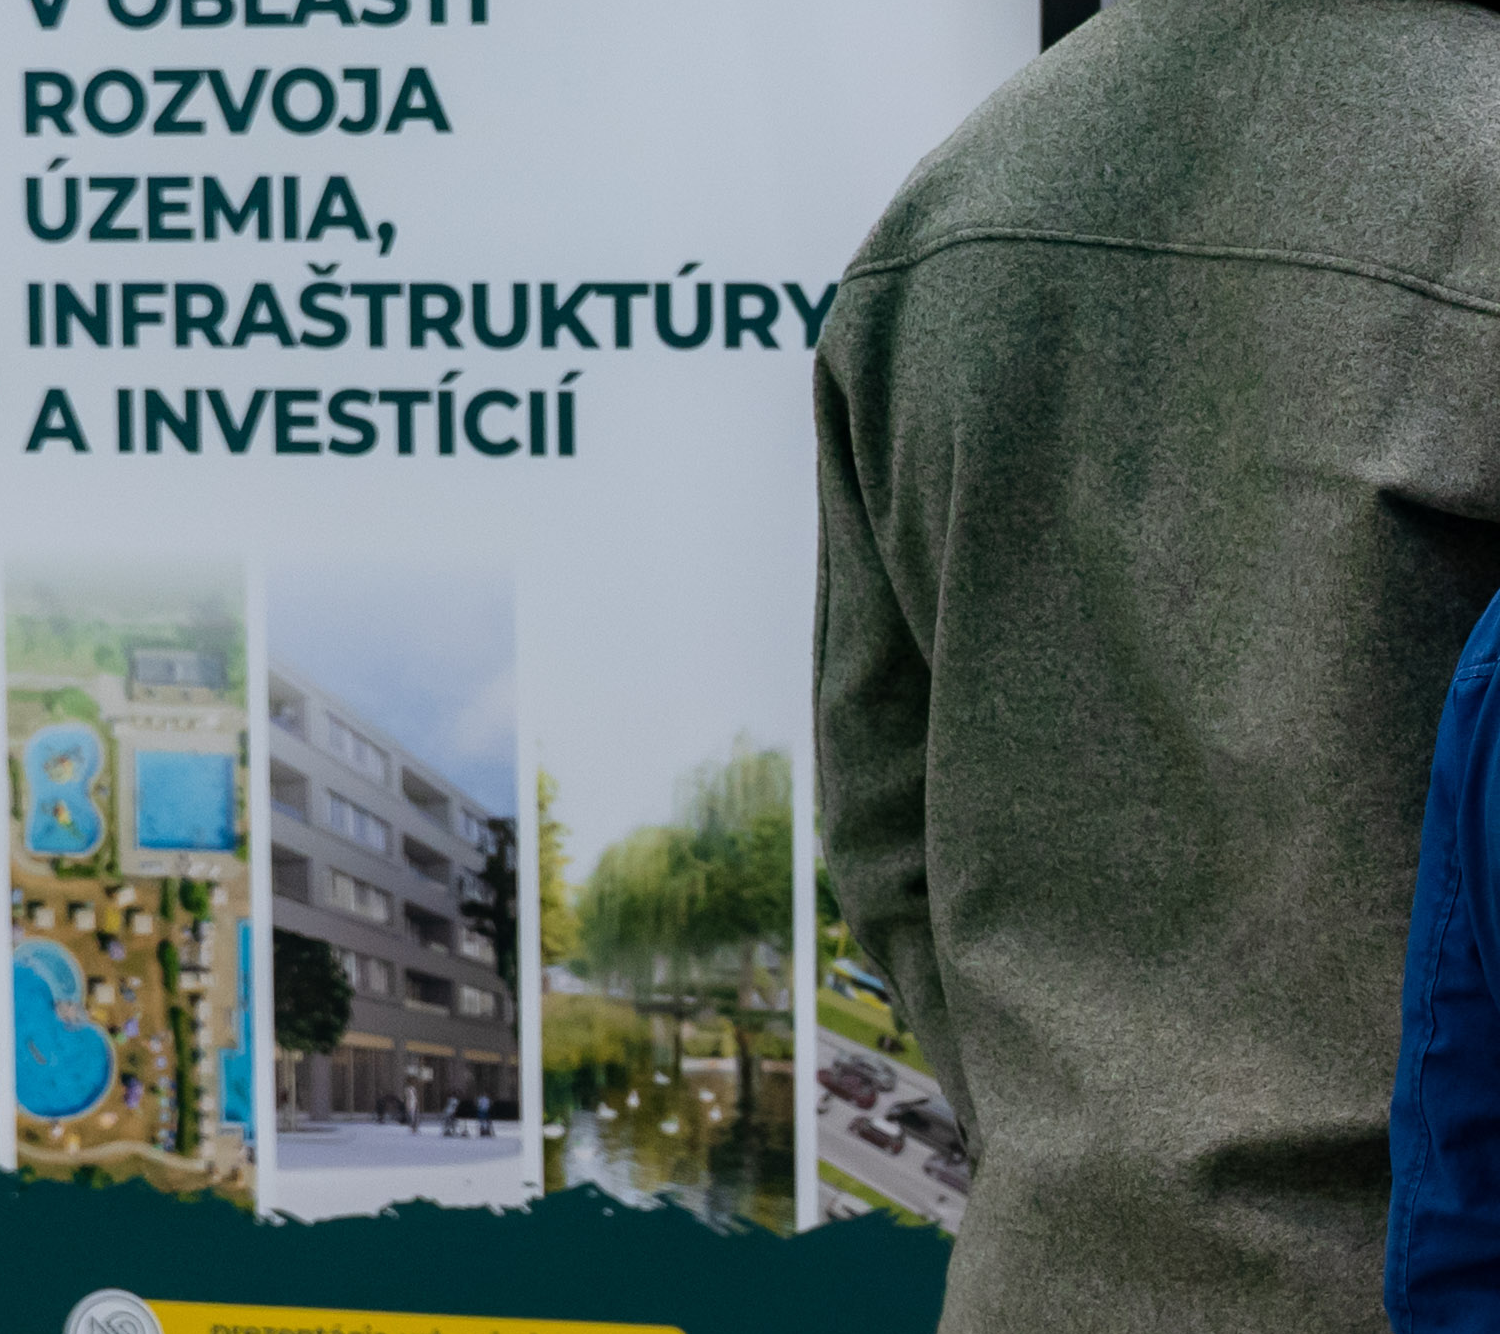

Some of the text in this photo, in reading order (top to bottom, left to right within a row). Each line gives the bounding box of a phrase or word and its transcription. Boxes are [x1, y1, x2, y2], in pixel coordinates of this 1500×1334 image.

[24, 67, 451, 136] ROZVOJA
[24, 158, 397, 255] ÚZEMIA,
[27, 262, 839, 350] INFRAŠTRUKTÚRY
[25, 371, 581, 457] A INVESTÍCIÍ
